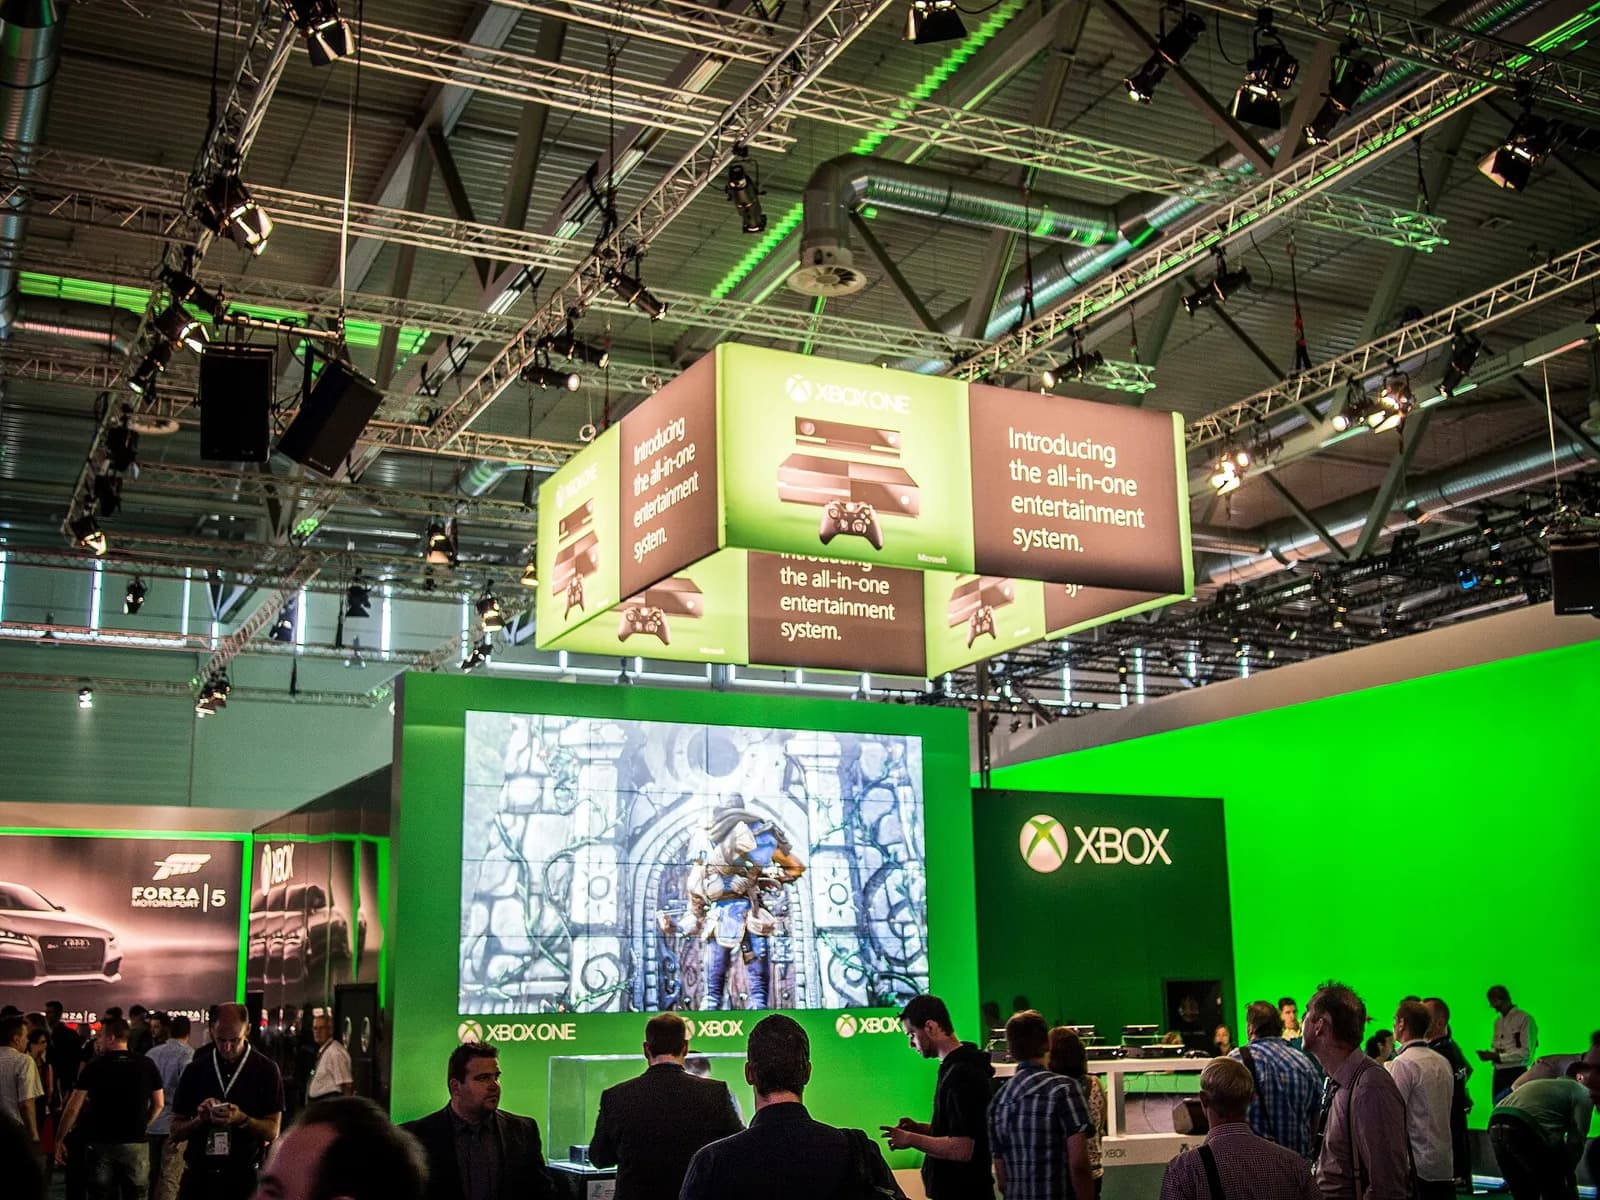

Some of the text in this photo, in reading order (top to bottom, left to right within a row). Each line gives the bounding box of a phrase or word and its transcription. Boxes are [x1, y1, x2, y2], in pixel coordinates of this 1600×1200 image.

[815, 382, 912, 415] XBOX ONE
[633, 416, 685, 466] Introducing
[1008, 427, 1116, 468] Introducing
[633, 473, 649, 497] the
[650, 443, 696, 486] all-in-one
[1009, 459, 1138, 496] the all-in-one
[633, 471, 699, 528] entertainment
[1011, 495, 1146, 529] entertainment
[633, 527, 668, 563] system.
[1012, 526, 1084, 552] system.
[780, 566, 890, 595] the all-in-one
[780, 595, 896, 621] entertainment
[780, 621, 842, 641] system.
[1074, 826, 1173, 865] XBOX
[272, 843, 294, 885] XBOX
[131, 887, 226, 907] FORZA 5
[131, 900, 200, 909] MOTORSPORT
[485, 1023, 577, 1041] XBOX ONE
[697, 1020, 743, 1037] XBOX
[859, 1017, 902, 1033] XBOX
